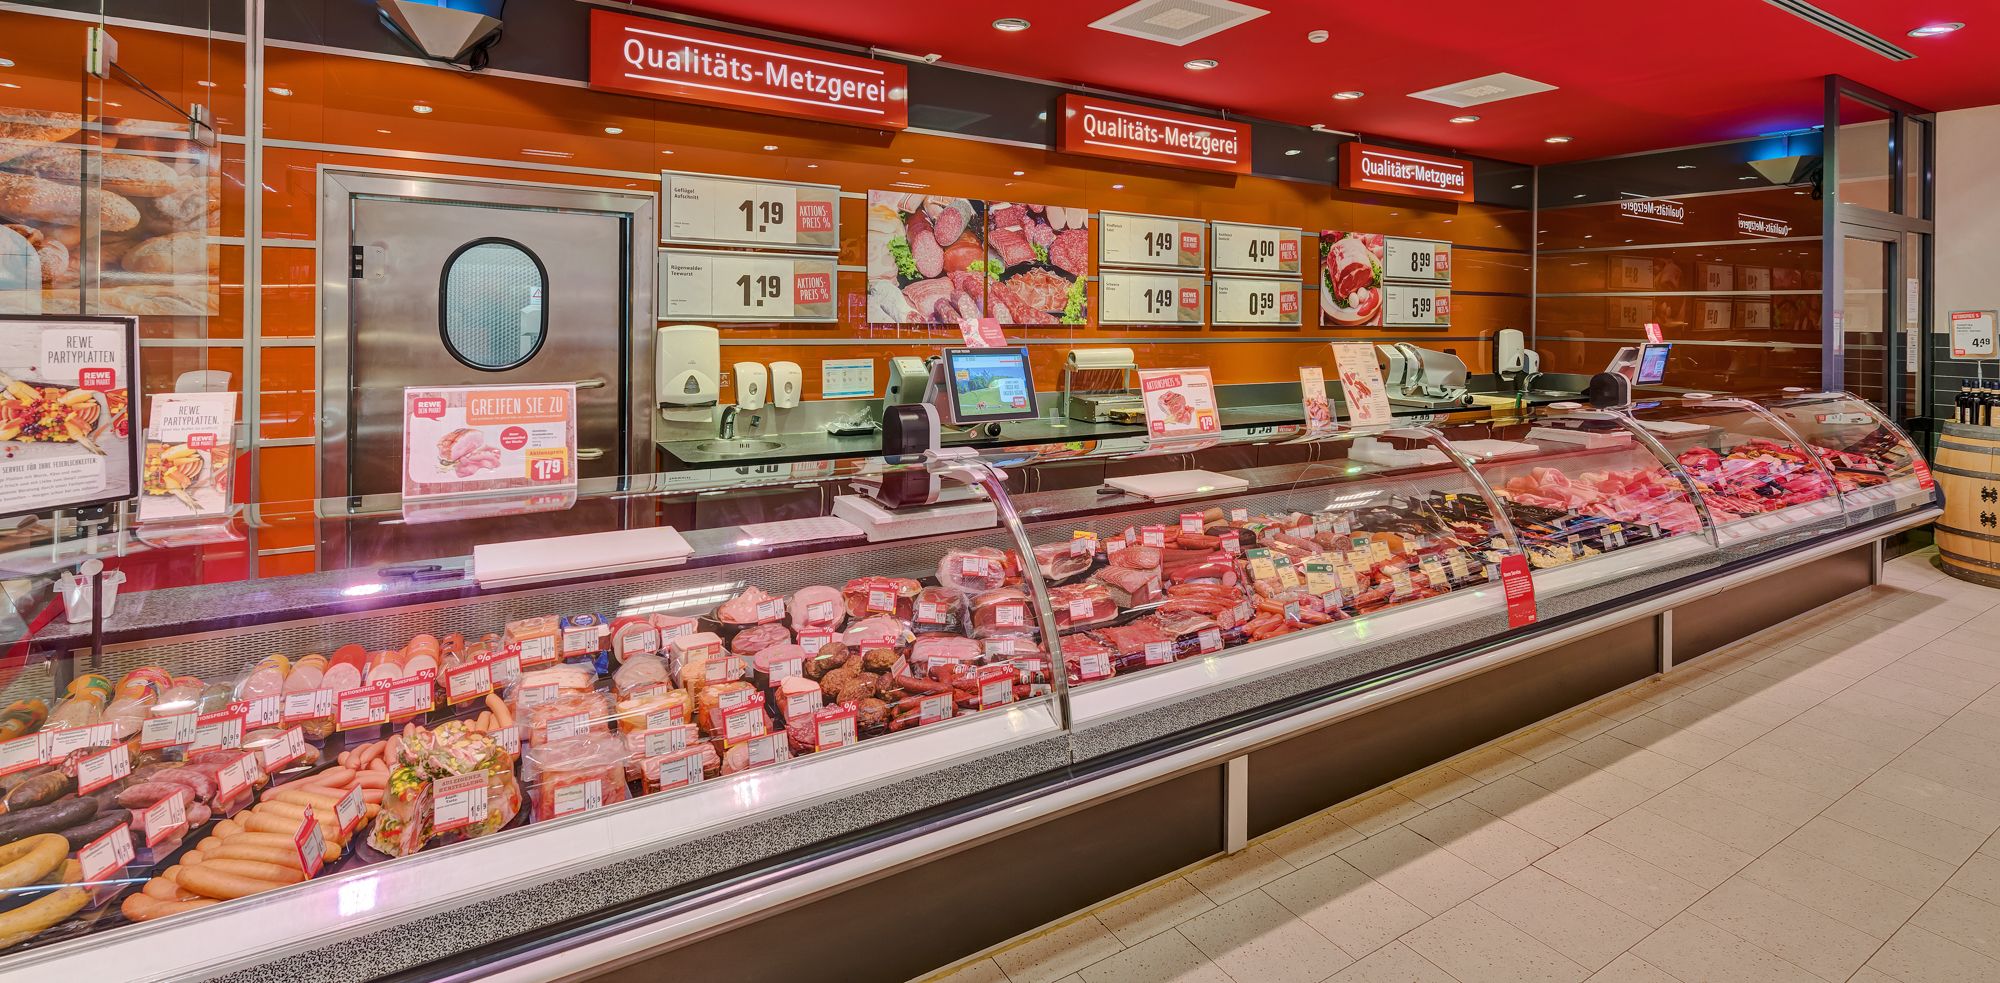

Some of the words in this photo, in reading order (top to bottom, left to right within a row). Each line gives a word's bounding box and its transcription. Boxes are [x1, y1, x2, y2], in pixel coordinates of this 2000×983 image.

[624, 39, 885, 102] Qualitäts-Metzgerei
[1083, 113, 1238, 156] Qualitäts-Metzgerei
[1361, 157, 1464, 187] Qualitäts-Metzgerei
[674, 193, 699, 201] Aufschnitt
[739, 200, 784, 233] 1.19
[800, 205, 828, 217] AKTIONS-
[802, 217, 821, 228] PREIS
[822, 217, 831, 228] %
[1144, 232, 1172, 257] 1.49
[1248, 239, 1274, 263] 4.00
[1411, 252, 1430, 272] 8.99
[797, 277, 826, 289] AKTIONS-
[736, 274, 781, 307] 1.19
[800, 289, 818, 301] PREIS
[820, 288, 829, 300] %
[1143, 288, 1172, 314] 1.49
[1249, 292, 1274, 315] 0.59
[1412, 298, 1431, 318] 5.99
[66, 335, 94, 349] REWE
[1972, 338, 1991, 348] 4.49
[48, 350, 115, 364] PARTYPLATTEN
[84, 371, 111, 379] REWE
[178, 405, 201, 415] REWE
[471, 398, 521, 416] GREIFEN
[526, 397, 544, 414] SIE
[549, 396, 563, 413] ZU
[2, 464, 24, 474] SERVICE
[534, 459, 561, 480] 1.79
[477, 653, 491, 663] %
[420, 669, 434, 679] %
[376, 679, 391, 690] %
[751, 692, 764, 703] %
[230, 703, 248, 715] %
[844, 701, 857, 712] %
